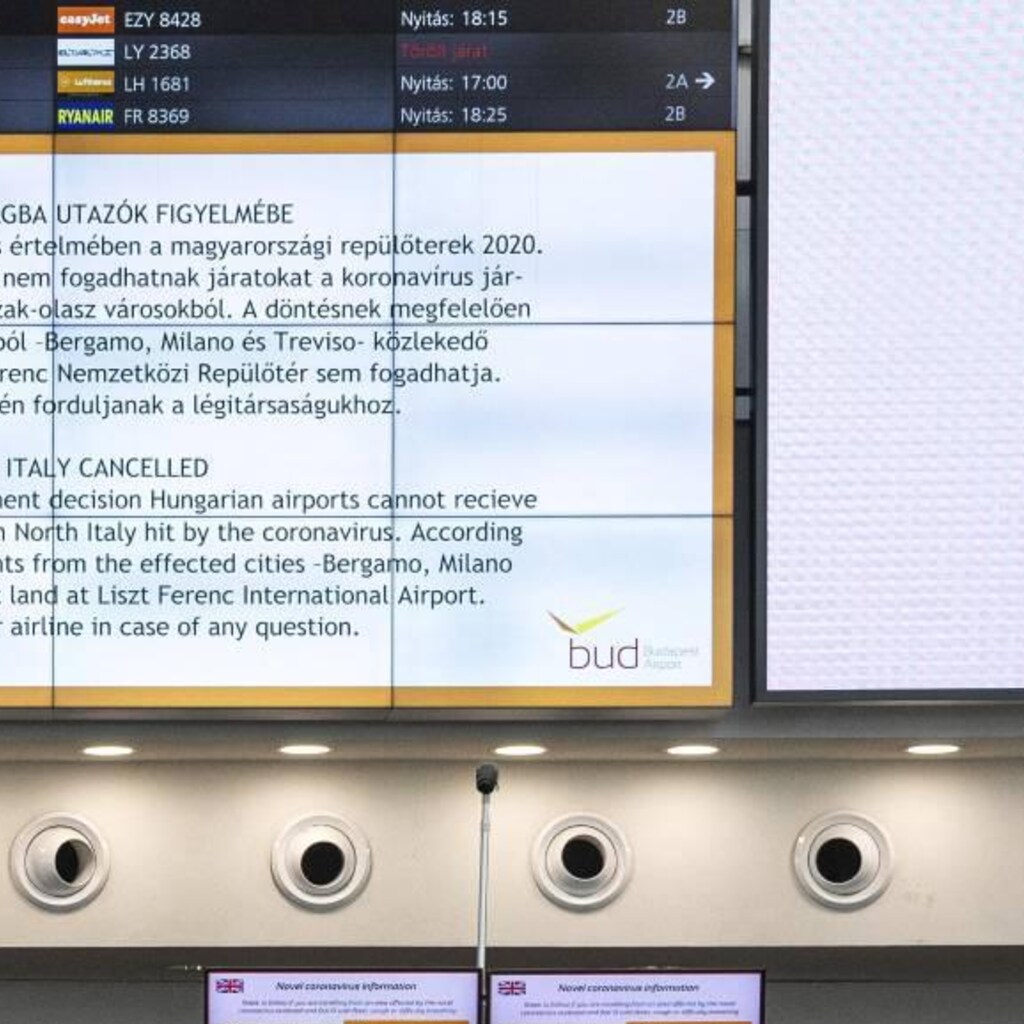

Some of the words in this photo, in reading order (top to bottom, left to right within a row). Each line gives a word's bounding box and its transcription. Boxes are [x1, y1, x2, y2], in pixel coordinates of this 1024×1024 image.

[59, 13, 111, 28] easyJet
[124, 11, 155, 28] EZY
[159, 11, 202, 28] 8428
[401, 10, 454, 31] Nyitás:
[462, 9, 508, 27] 18:15
[666, 8, 687, 25] 2B
[124, 44, 145, 60] LY
[149, 43, 191, 60] 2368
[58, 108, 114, 124] RYANAIR
[124, 108, 144, 124] FR
[147, 108, 190, 125] 8369
[400, 107, 454, 127] Nyitás:
[462, 106, 508, 123] 18:25
[665, 105, 686, 122] 2B
[56, 198, 148, 225] UTAZÓK
[156, 198, 293, 225] FIGYELMÉBE
[9, 233, 141, 257] értelmében
[149, 240, 162, 256] a
[171, 233, 332, 261] magyarországi
[341, 233, 475, 260] repülőterek
[482, 234, 543, 255] 2020.
[36, 331, 151, 357] -Bergamo,
[160, 331, 235, 352] Milano
[241, 329, 267, 352] és
[273, 330, 364, 352] Treviso-
[373, 329, 489, 352] közlekedő
[33, 394, 164, 420] forduljanak
[171, 399, 185, 415] a
[193, 392, 401, 420] légitársaságukhoz.
[7, 457, 71, 478] ITALY
[78, 457, 209, 478] CANCELLED
[48, 488, 142, 510] decision
[150, 489, 263, 515] Hungarian
[271, 489, 360, 515] airports
[367, 491, 445, 510] cannot
[454, 489, 538, 510] recieve
[10, 584, 59, 605] land
[66, 586, 89, 606] at
[98, 584, 150, 606] Liszt
[158, 584, 234, 606] Ferenc
[243, 584, 389, 606] International
[397, 584, 485, 610] Airport.
[569, 637, 639, 670] bud
